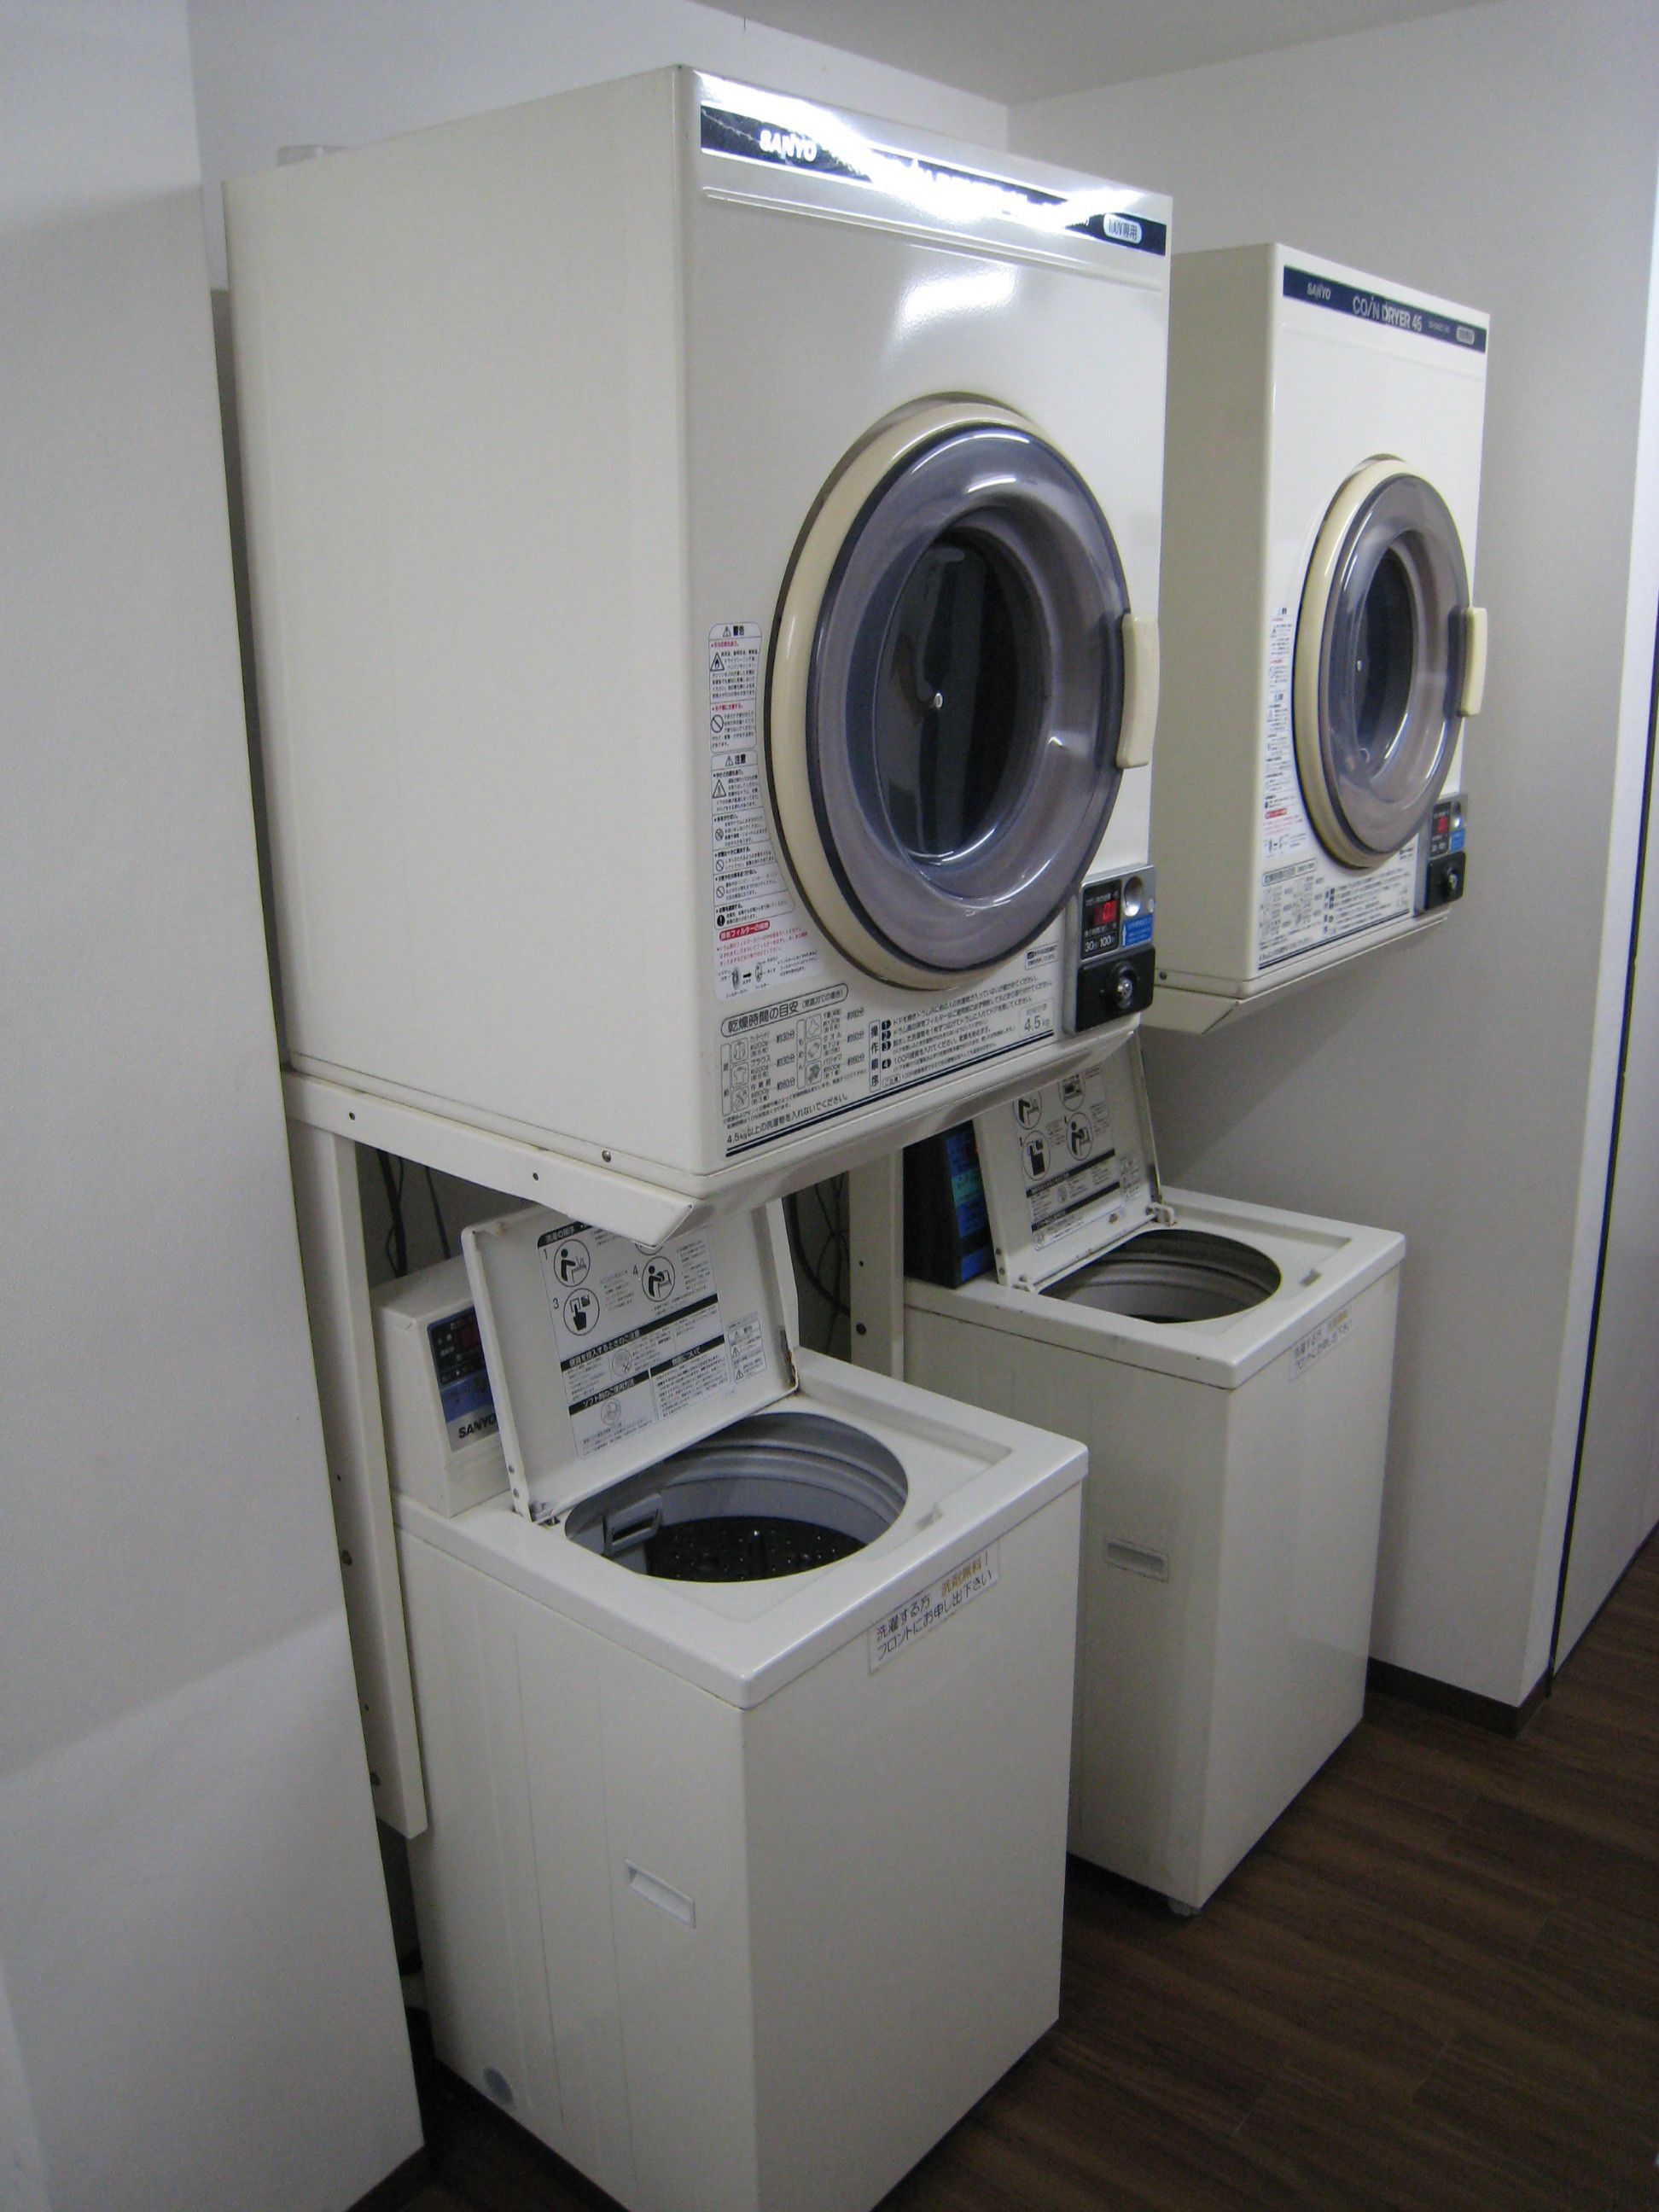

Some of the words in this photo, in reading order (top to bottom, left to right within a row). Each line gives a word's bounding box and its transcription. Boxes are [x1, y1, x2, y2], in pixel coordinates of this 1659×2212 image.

[760, 130, 817, 162] SANYO
[1307, 282, 1331, 300] SANYO
[1382, 303, 1411, 329] DRYER
[728, 1000, 798, 1033] 乾燥時間の目安
[632, 1265, 639, 1276] 4
[553, 1298, 559, 1309] 3
[877, 1569, 992, 1662] フロントにお申し出下さい
